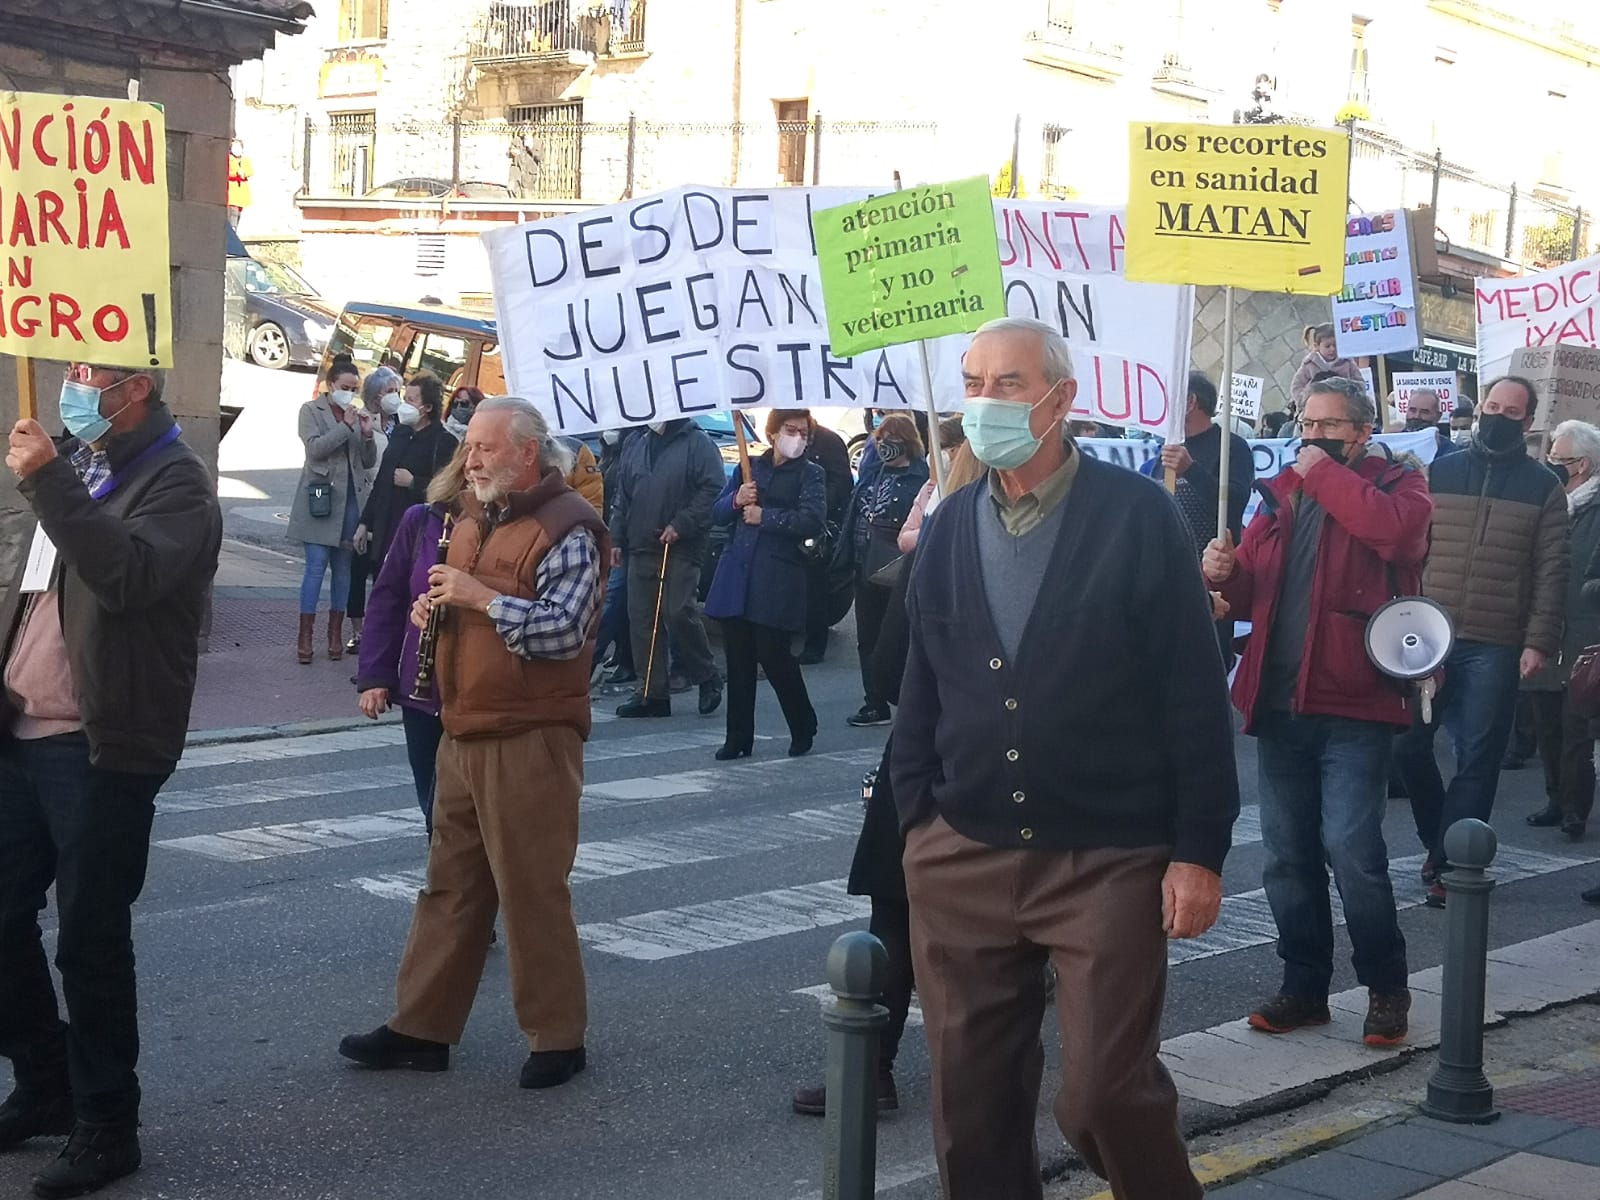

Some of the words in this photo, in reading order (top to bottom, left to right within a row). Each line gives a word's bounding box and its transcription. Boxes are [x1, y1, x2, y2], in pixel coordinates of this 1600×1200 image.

[1145, 126, 1187, 152] los
[1197, 134, 1327, 158] recortes
[1151, 169, 1185, 188] en
[1195, 167, 1319, 195] sanidad
[0, 178, 131, 249] ARIA
[842, 189, 956, 233] atención
[1156, 201, 1312, 240] MATAN
[525, 191, 773, 287] DESDE
[845, 222, 961, 274] primaria
[880, 275, 894, 300] y
[902, 267, 935, 290] no
[1476, 270, 1600, 324] MEDIC
[544, 269, 818, 361] JUEGAN
[842, 289, 985, 337] veterinaria
[551, 342, 908, 429] NUESTRA
